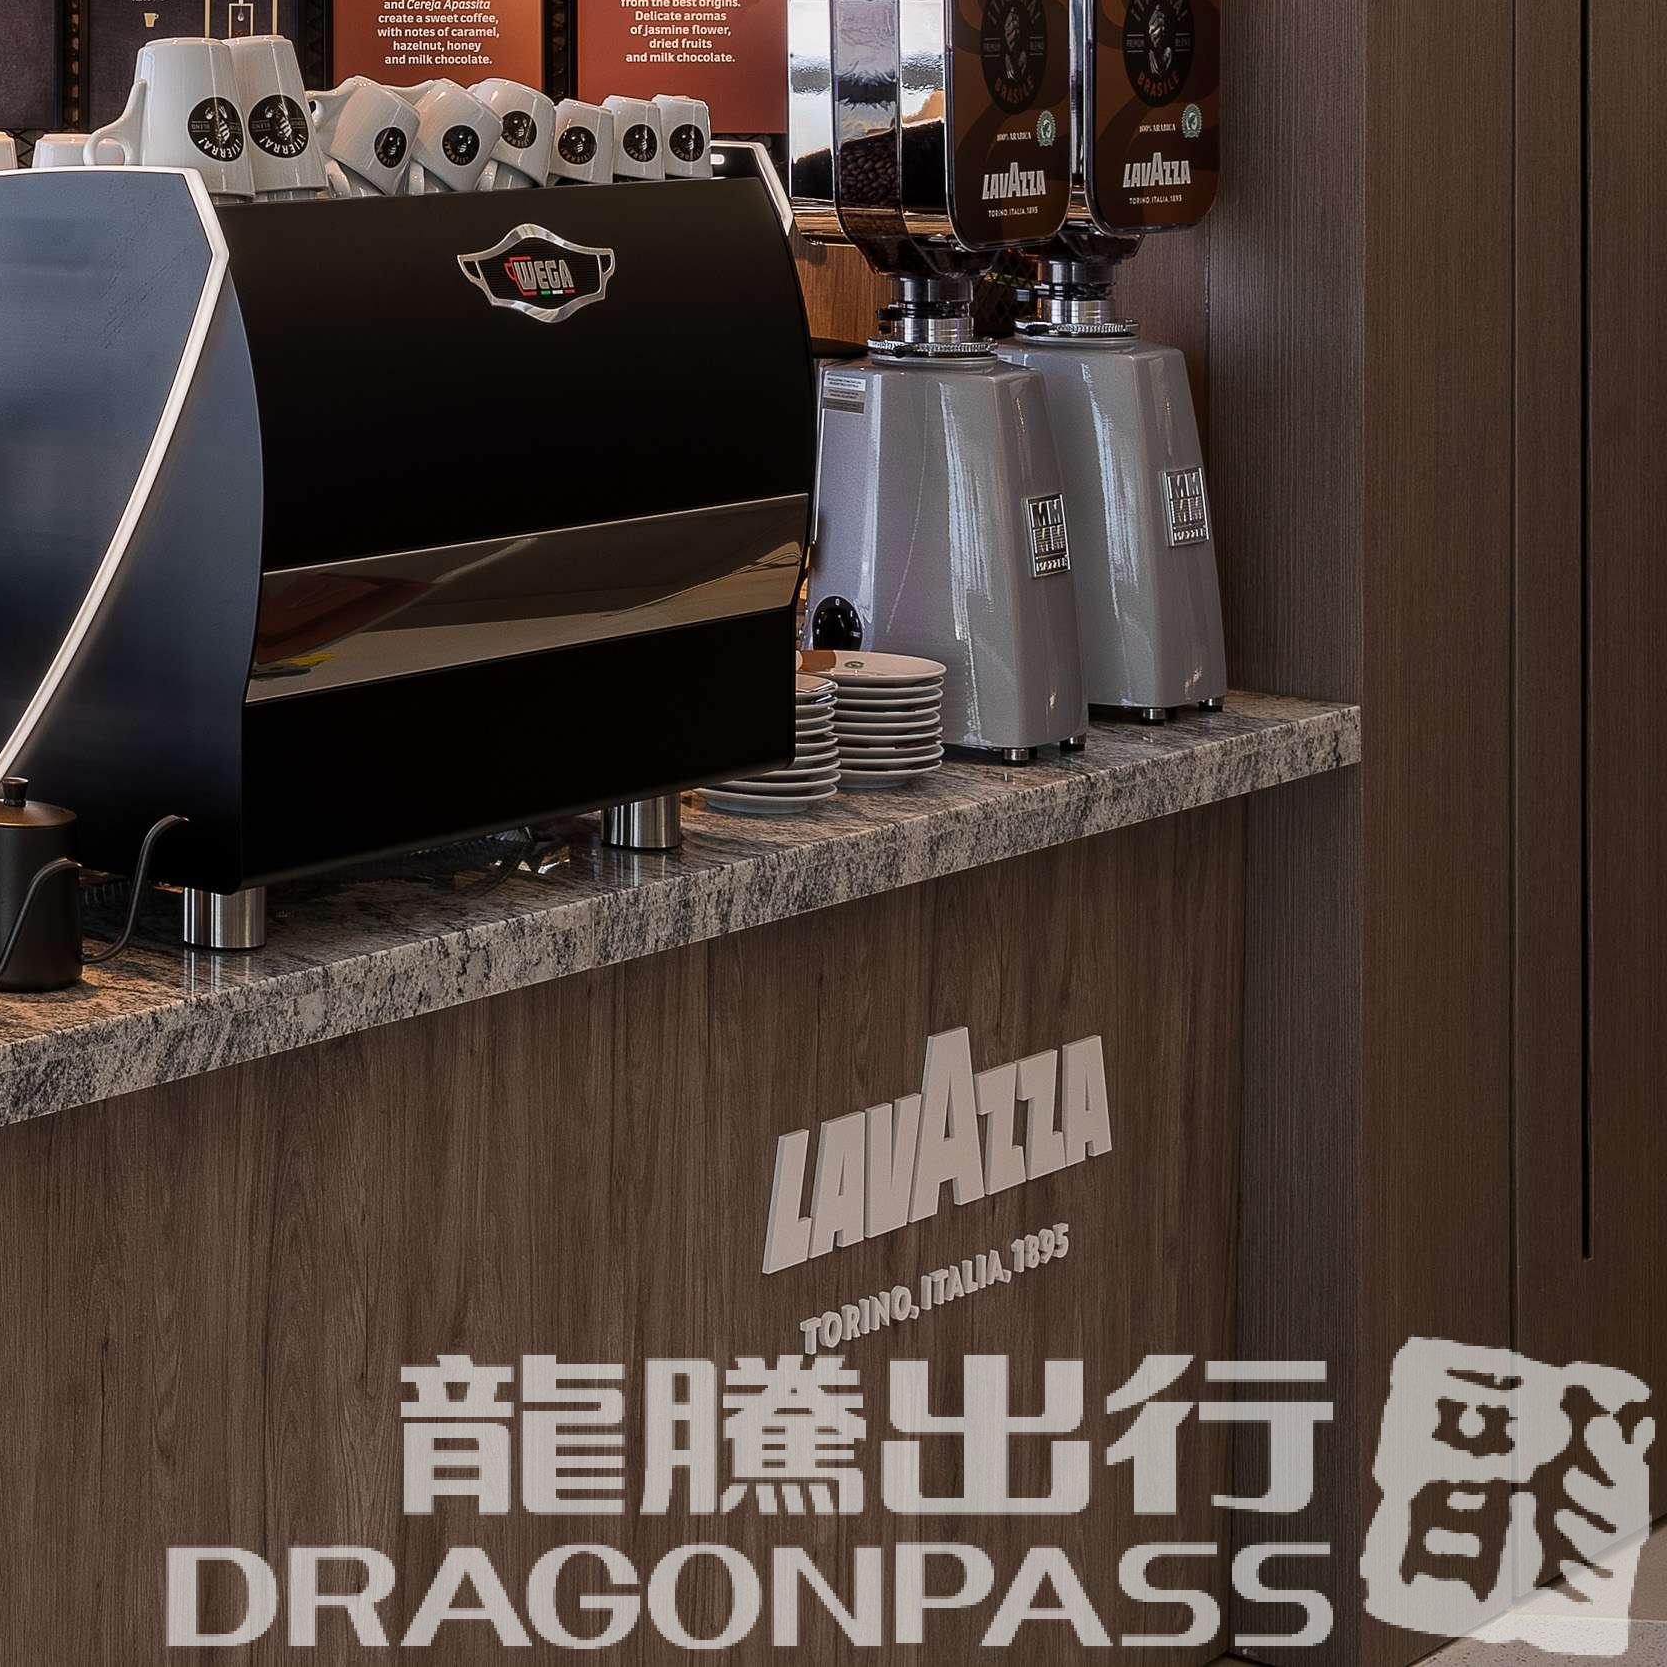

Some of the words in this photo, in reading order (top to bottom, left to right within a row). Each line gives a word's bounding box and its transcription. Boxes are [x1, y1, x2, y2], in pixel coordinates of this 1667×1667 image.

[384, 0, 405, 10] and
[406, 0, 442, 11] Cereja
[443, 0, 491, 11] Apassita
[378, 14, 414, 23] create
[425, 14, 458, 23] sweet
[460, 13, 499, 25] coffee,
[635, 10, 682, 21] Delicate
[683, 12, 727, 21] aromas
[377, 27, 402, 37] with
[404, 27, 435, 37] notes
[437, 27, 450, 37] of
[451, 27, 500, 38] caramel,
[630, 24, 643, 35] of
[643, 24, 689, 36] jasmine
[692, 24, 732, 36] flower,
[393, 41, 445, 52] hazelnut,
[447, 41, 482, 53] honey
[649, 38, 679, 48] dried
[681, 38, 713, 48] fruits
[385, 54, 406, 65] and
[408, 54, 433, 65] milk
[435, 54, 492, 65] chocolate.
[626, 52, 648, 62] and
[650, 52, 675, 62] milk
[676, 52, 736, 62] chocolate.
[1122, 152, 1191, 188] LAVAZZA
[982, 162, 1046, 200] LAVAZZA
[513, 259, 575, 291] WEGA
[762, 1026, 1112, 1275] LAVAZZA
